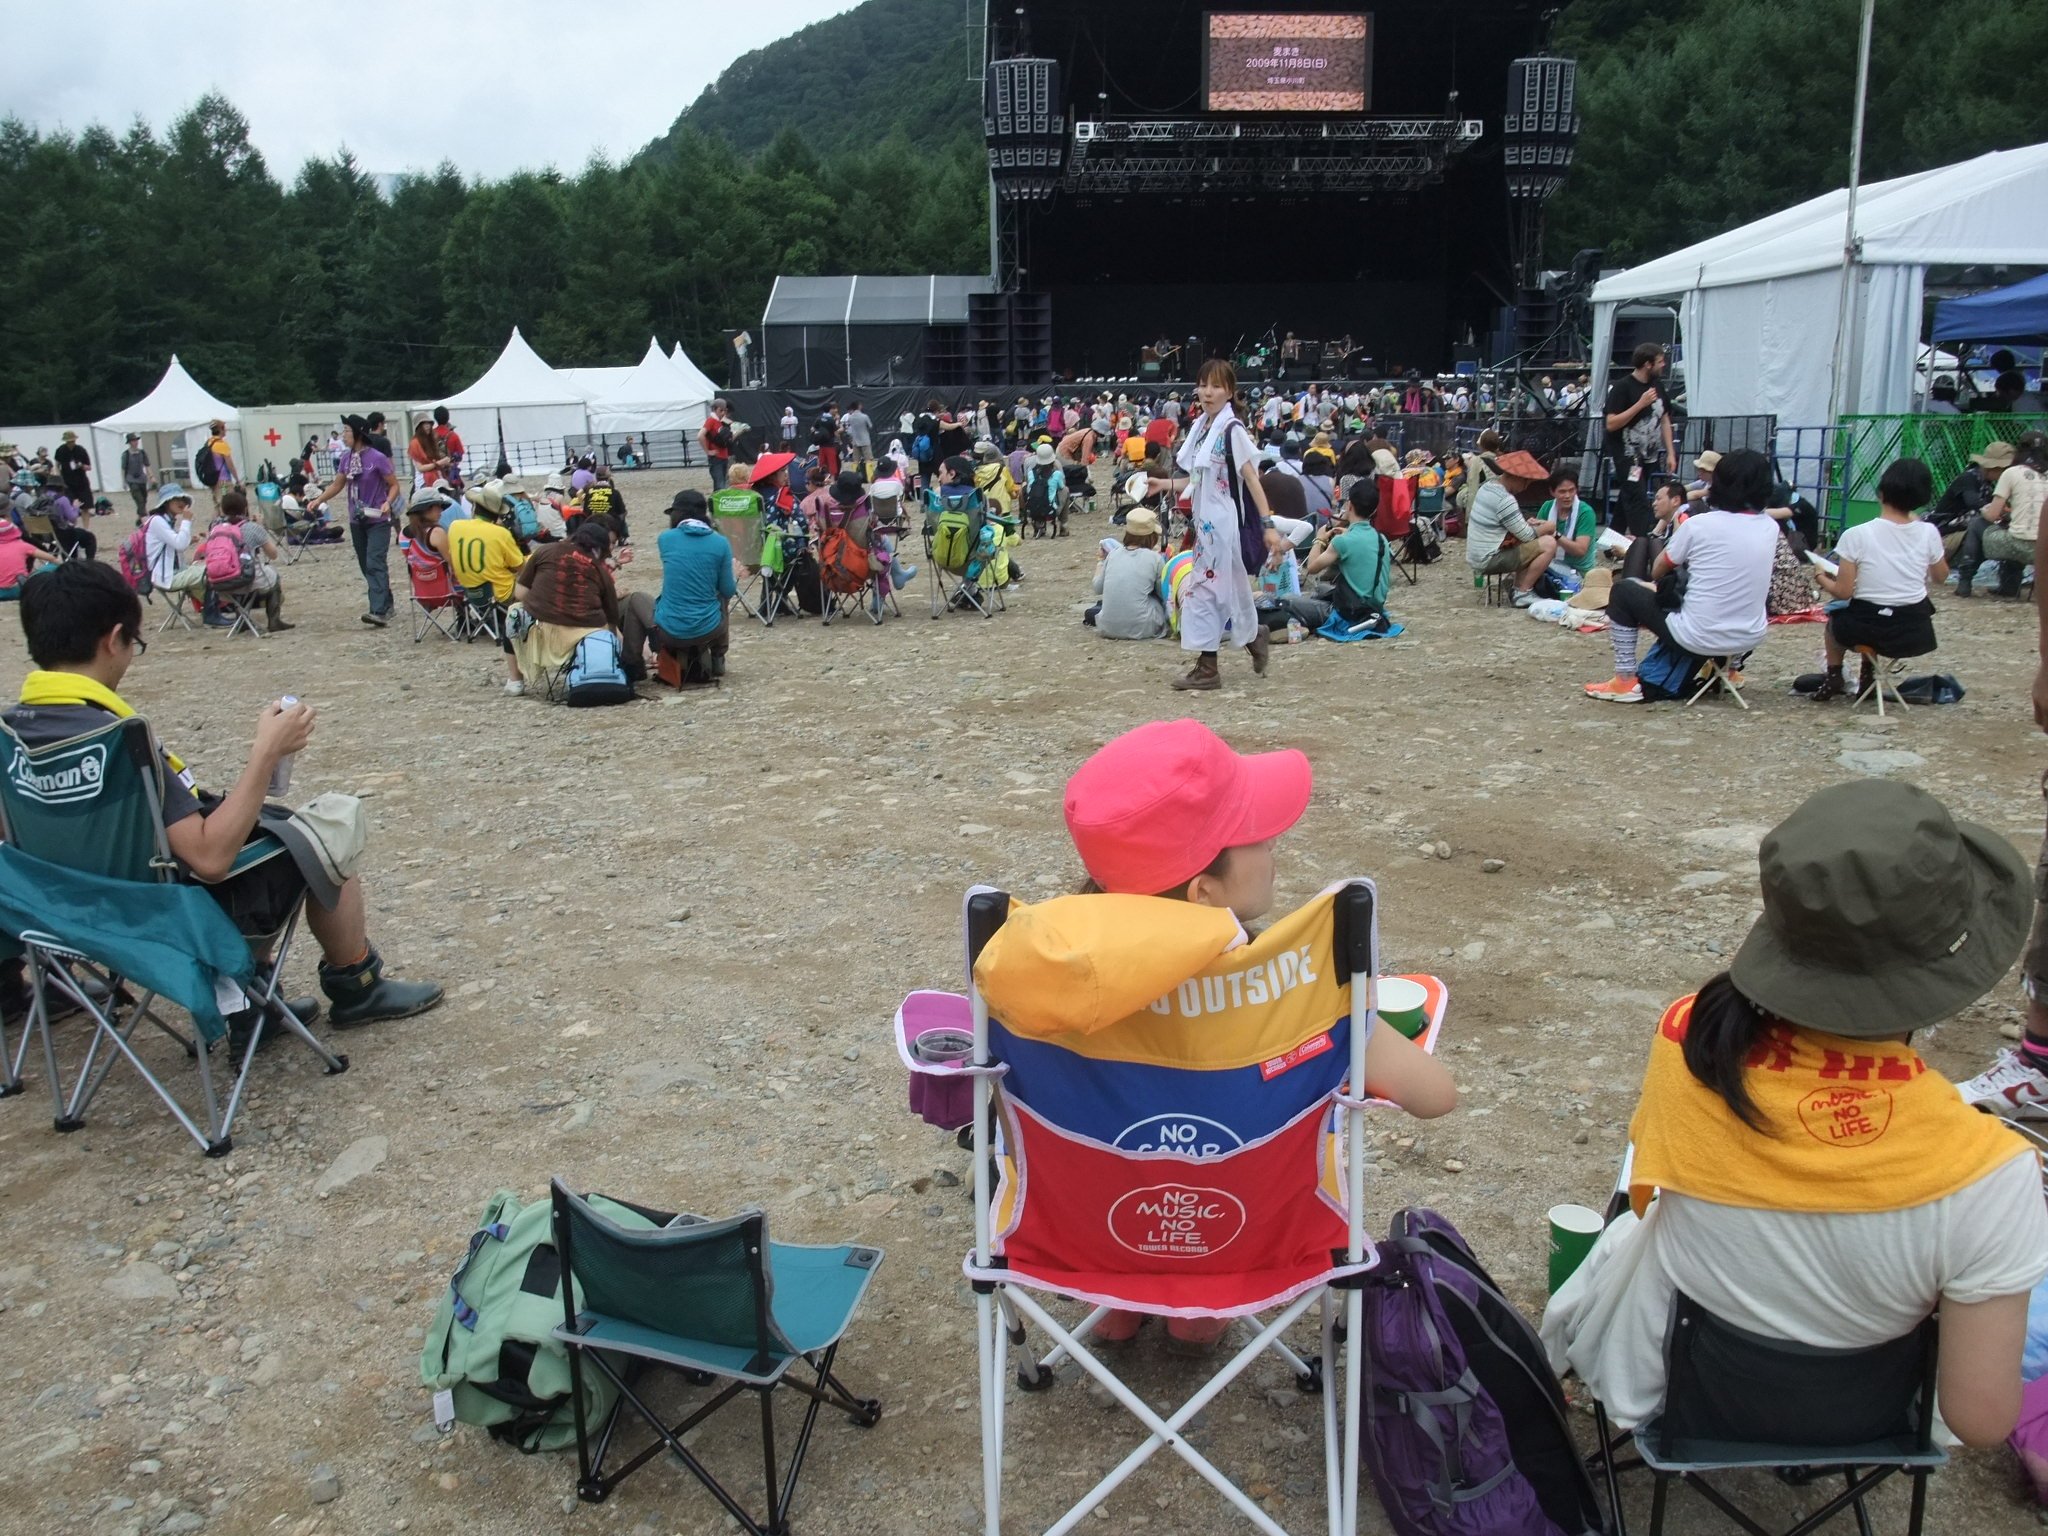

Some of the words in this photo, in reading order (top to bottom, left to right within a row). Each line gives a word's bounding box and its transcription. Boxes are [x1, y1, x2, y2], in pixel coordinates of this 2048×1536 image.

[1246, 59, 1328, 69] 2009年11月8日(日)
[458, 536, 485, 574] 10
[19, 756, 81, 790] Cman
[1178, 943, 1317, 1018] OUTSIDE
[1833, 1105, 1861, 1122] NO
[1160, 1123, 1198, 1143] NO
[1162, 1191, 1199, 1205] NO
[1160, 1219, 1197, 1232] NO
[1147, 1230, 1206, 1244] LIFE.
[1138, 1243, 1168, 1252] TOWER
[1170, 1245, 1209, 1253] RECORDS
